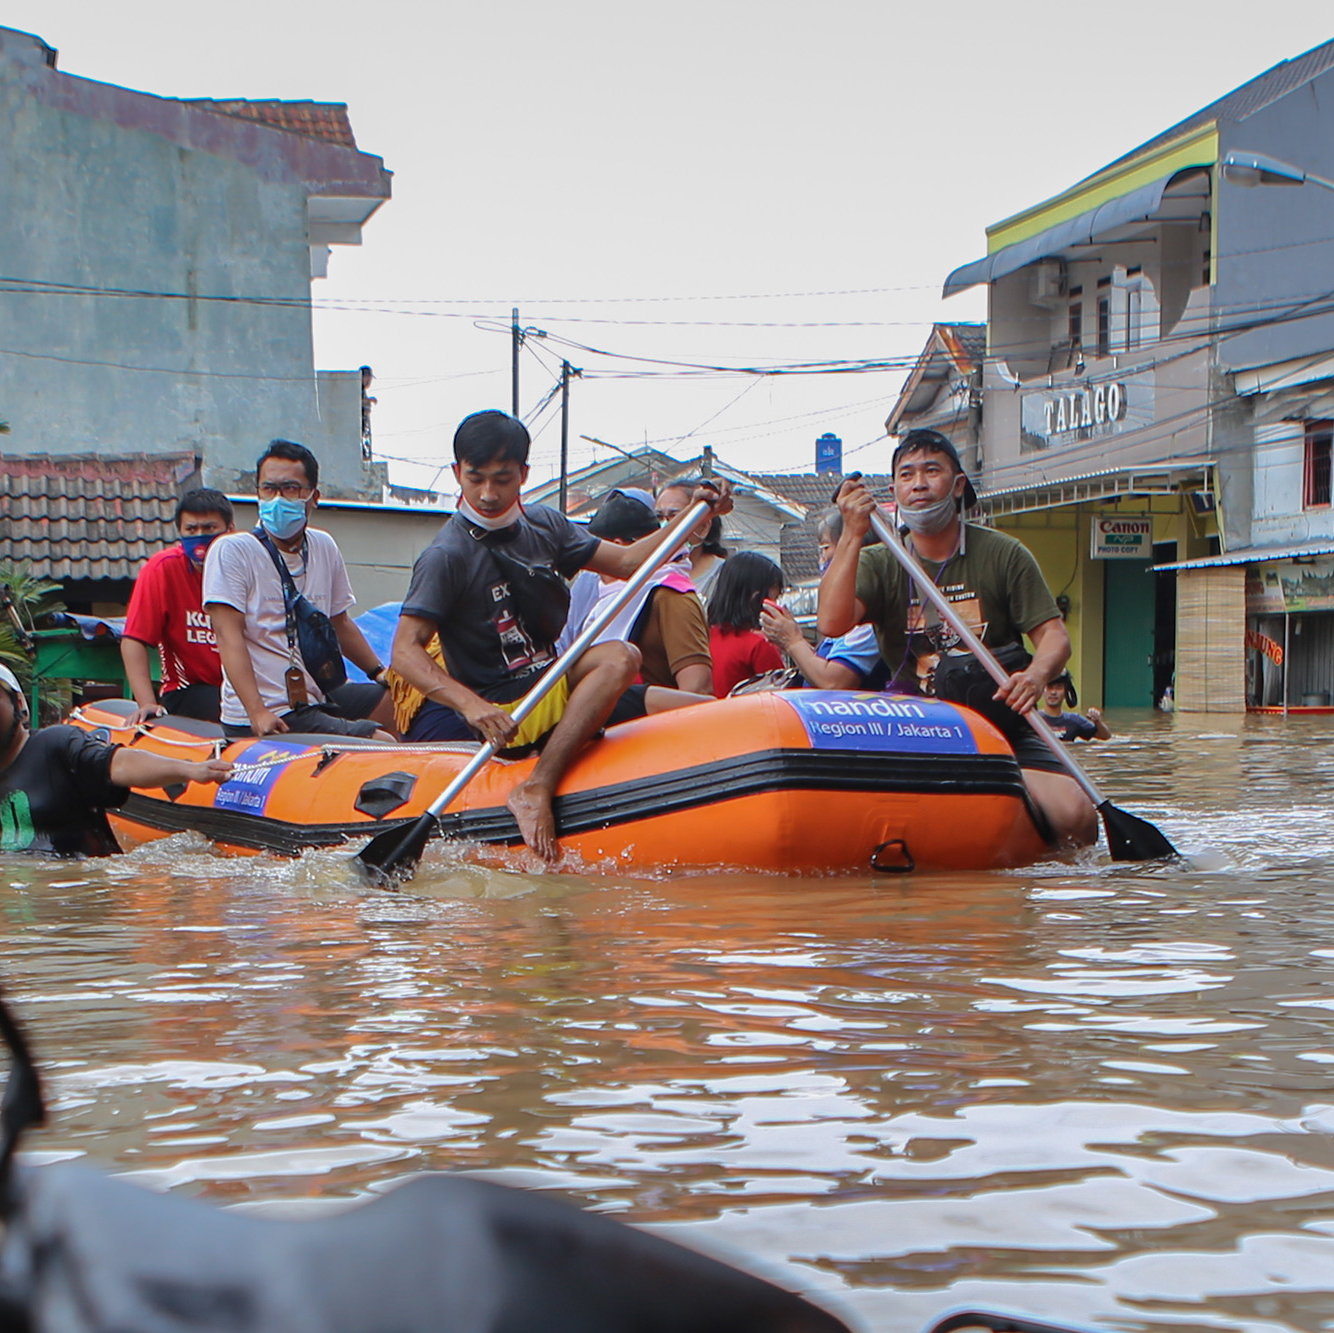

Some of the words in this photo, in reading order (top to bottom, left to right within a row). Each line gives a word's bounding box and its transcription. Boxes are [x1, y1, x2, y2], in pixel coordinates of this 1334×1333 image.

[1044, 383, 1120, 436] TALAGO
[1099, 520, 1150, 534] Canon
[810, 721, 867, 738] Region
[868, 722, 884, 736] III
[897, 722, 952, 739] Jakarta
[953, 725, 963, 738] 1
